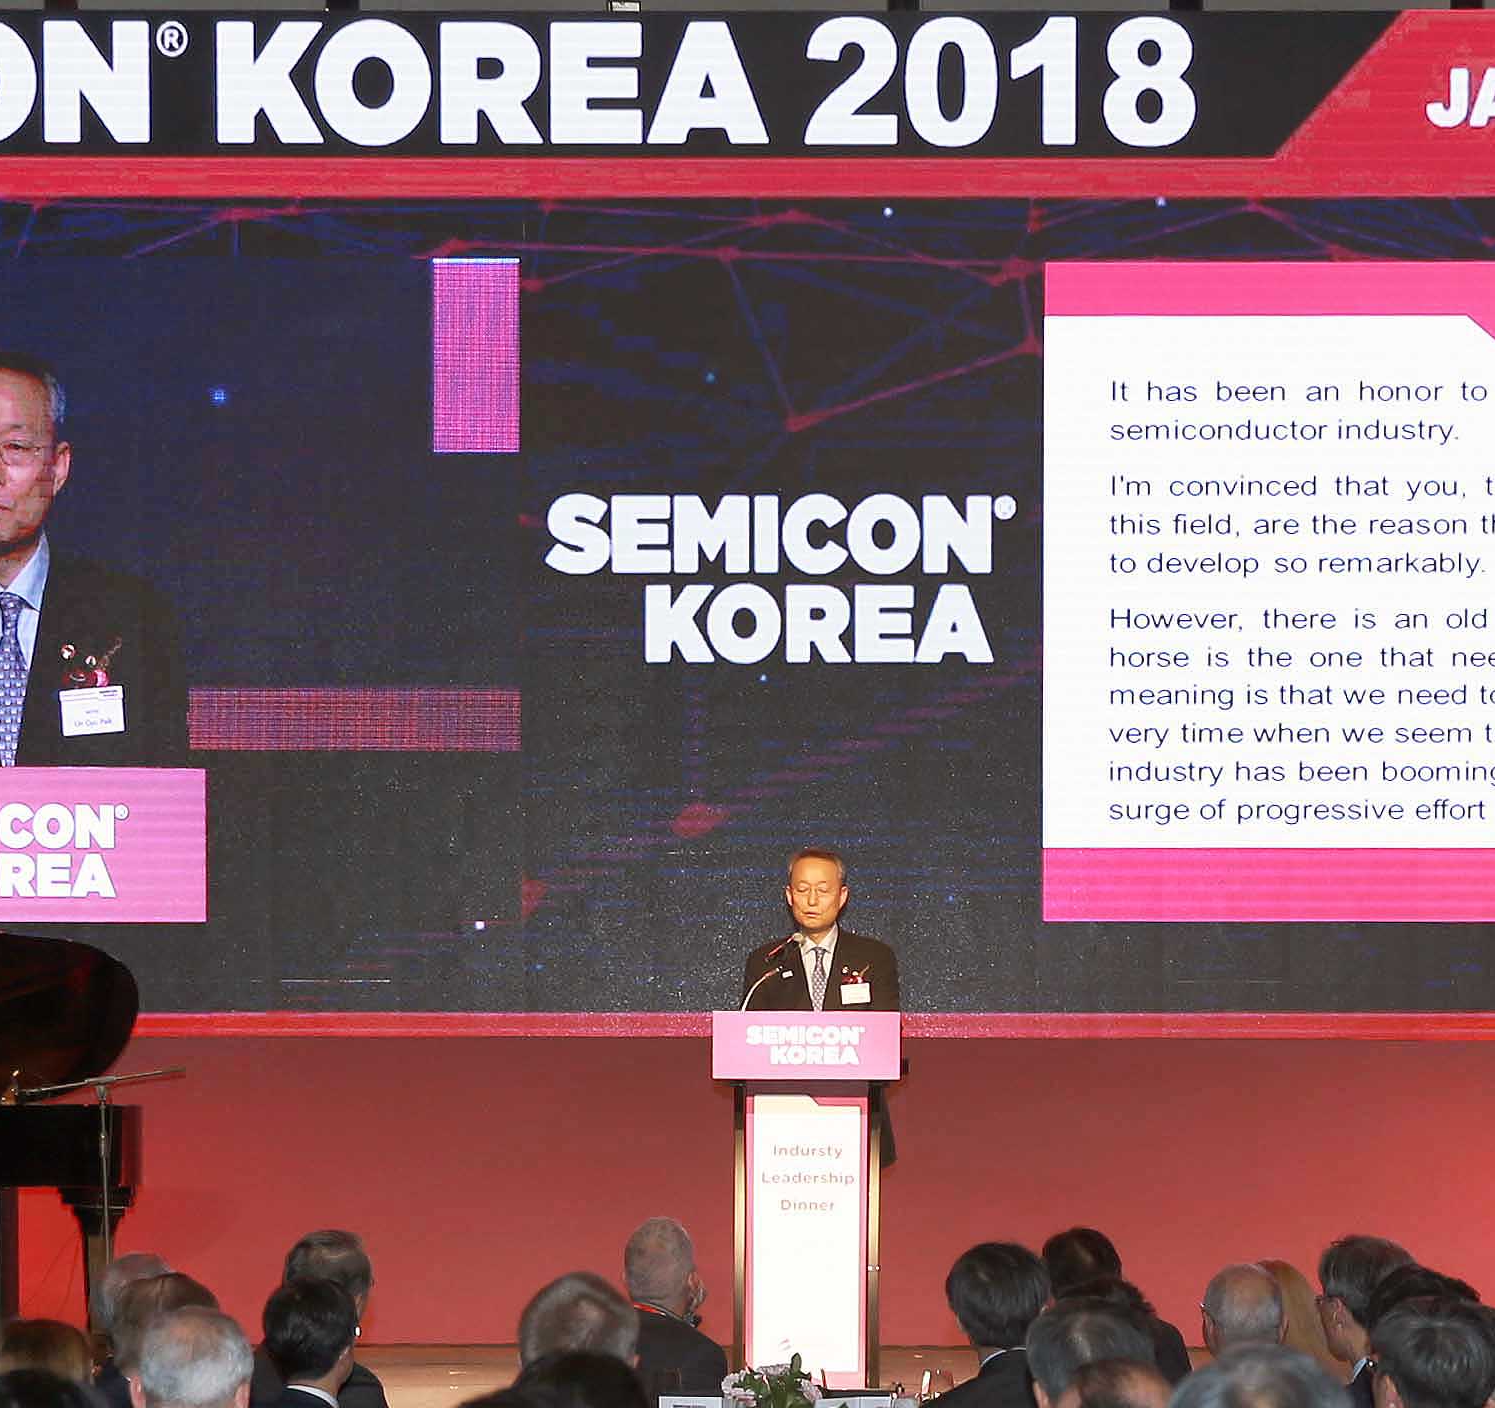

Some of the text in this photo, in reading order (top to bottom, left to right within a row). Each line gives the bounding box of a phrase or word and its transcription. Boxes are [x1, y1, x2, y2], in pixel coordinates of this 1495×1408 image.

[216, 19, 769, 146] KOREA
[803, 16, 1196, 147] 2018
[1111, 379, 1129, 402] It
[1147, 380, 1198, 402] has
[1216, 380, 1286, 403] been
[1305, 385, 1339, 403] an
[1359, 379, 1444, 402] honor
[1460, 381, 1488, 402] to
[1110, 418, 1459, 446] semiconductor industry.
[1111, 474, 1151, 497] I'm
[1169, 474, 1317, 497] convinced
[1334, 474, 1390, 497] that
[1406, 479, 1466, 502] you,
[1108, 513, 1161, 536] this
[1172, 513, 1240, 538] field,
[1253, 518, 1300, 535] are
[1311, 513, 1357, 536] the
[1369, 518, 1467, 536] reason
[1109, 551, 1486, 579] to develop so remarkably.
[645, 583, 994, 664] KOREA
[1110, 607, 1243, 633] However,
[1262, 607, 1337, 630] there
[1354, 607, 1377, 630] is
[1394, 613, 1428, 630] an
[1445, 607, 1488, 630] old
[1109, 646, 1190, 668] horse
[1207, 645, 1230, 668] is
[1247, 646, 1293, 668] the
[1309, 651, 1363, 668] one
[1379, 646, 1435, 668] that
[1109, 683, 1234, 711] meaning
[1246, 683, 1269, 705] is
[1279, 683, 1334, 706] that
[1342, 688, 1386, 705] we
[1397, 683, 1467, 706] need
[1108, 727, 1170, 749] very
[1180, 722, 1244, 744] time
[1252, 722, 1330, 744] when
[1341, 727, 1384, 744] we
[1394, 727, 1472, 744] seem
[1109, 760, 1224, 788] industry
[1235, 760, 1286, 782] has
[1298, 760, 1368, 783] been
[1109, 803, 1190, 826] surge
[1199, 798, 1227, 821] of
[1237, 799, 1405, 826] progressive
[1415, 798, 1486, 821] effort
[769, 1046, 860, 1065] KOREA
[772, 1144, 843, 1160] Indursty
[761, 1171, 855, 1186] Leadership
[779, 1199, 836, 1212] Dinner
